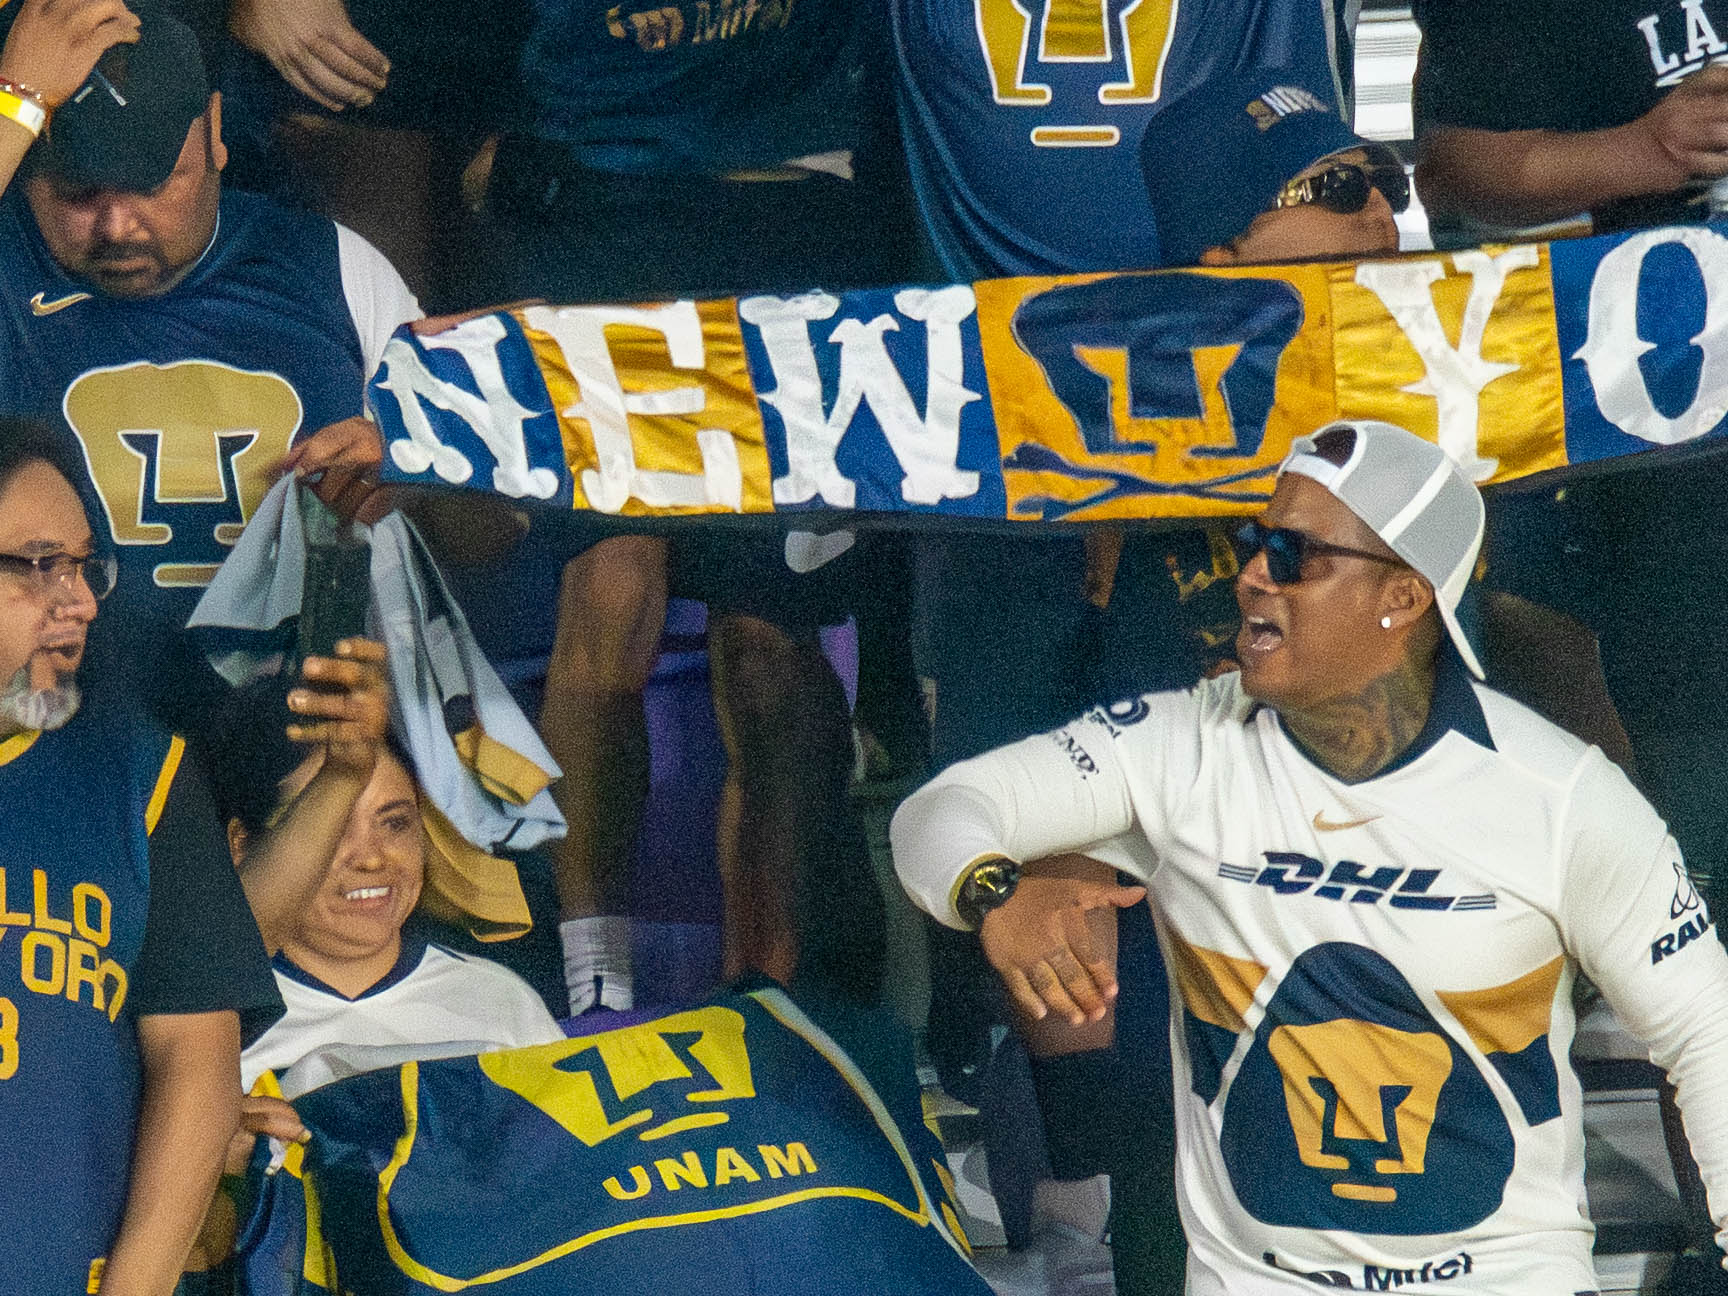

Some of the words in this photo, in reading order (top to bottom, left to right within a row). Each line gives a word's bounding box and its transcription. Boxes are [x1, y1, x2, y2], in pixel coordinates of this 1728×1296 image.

[378, 284, 981, 515] NEW
[1256, 851, 1460, 911] DHL
[602, 1140, 820, 1202] UNAM
